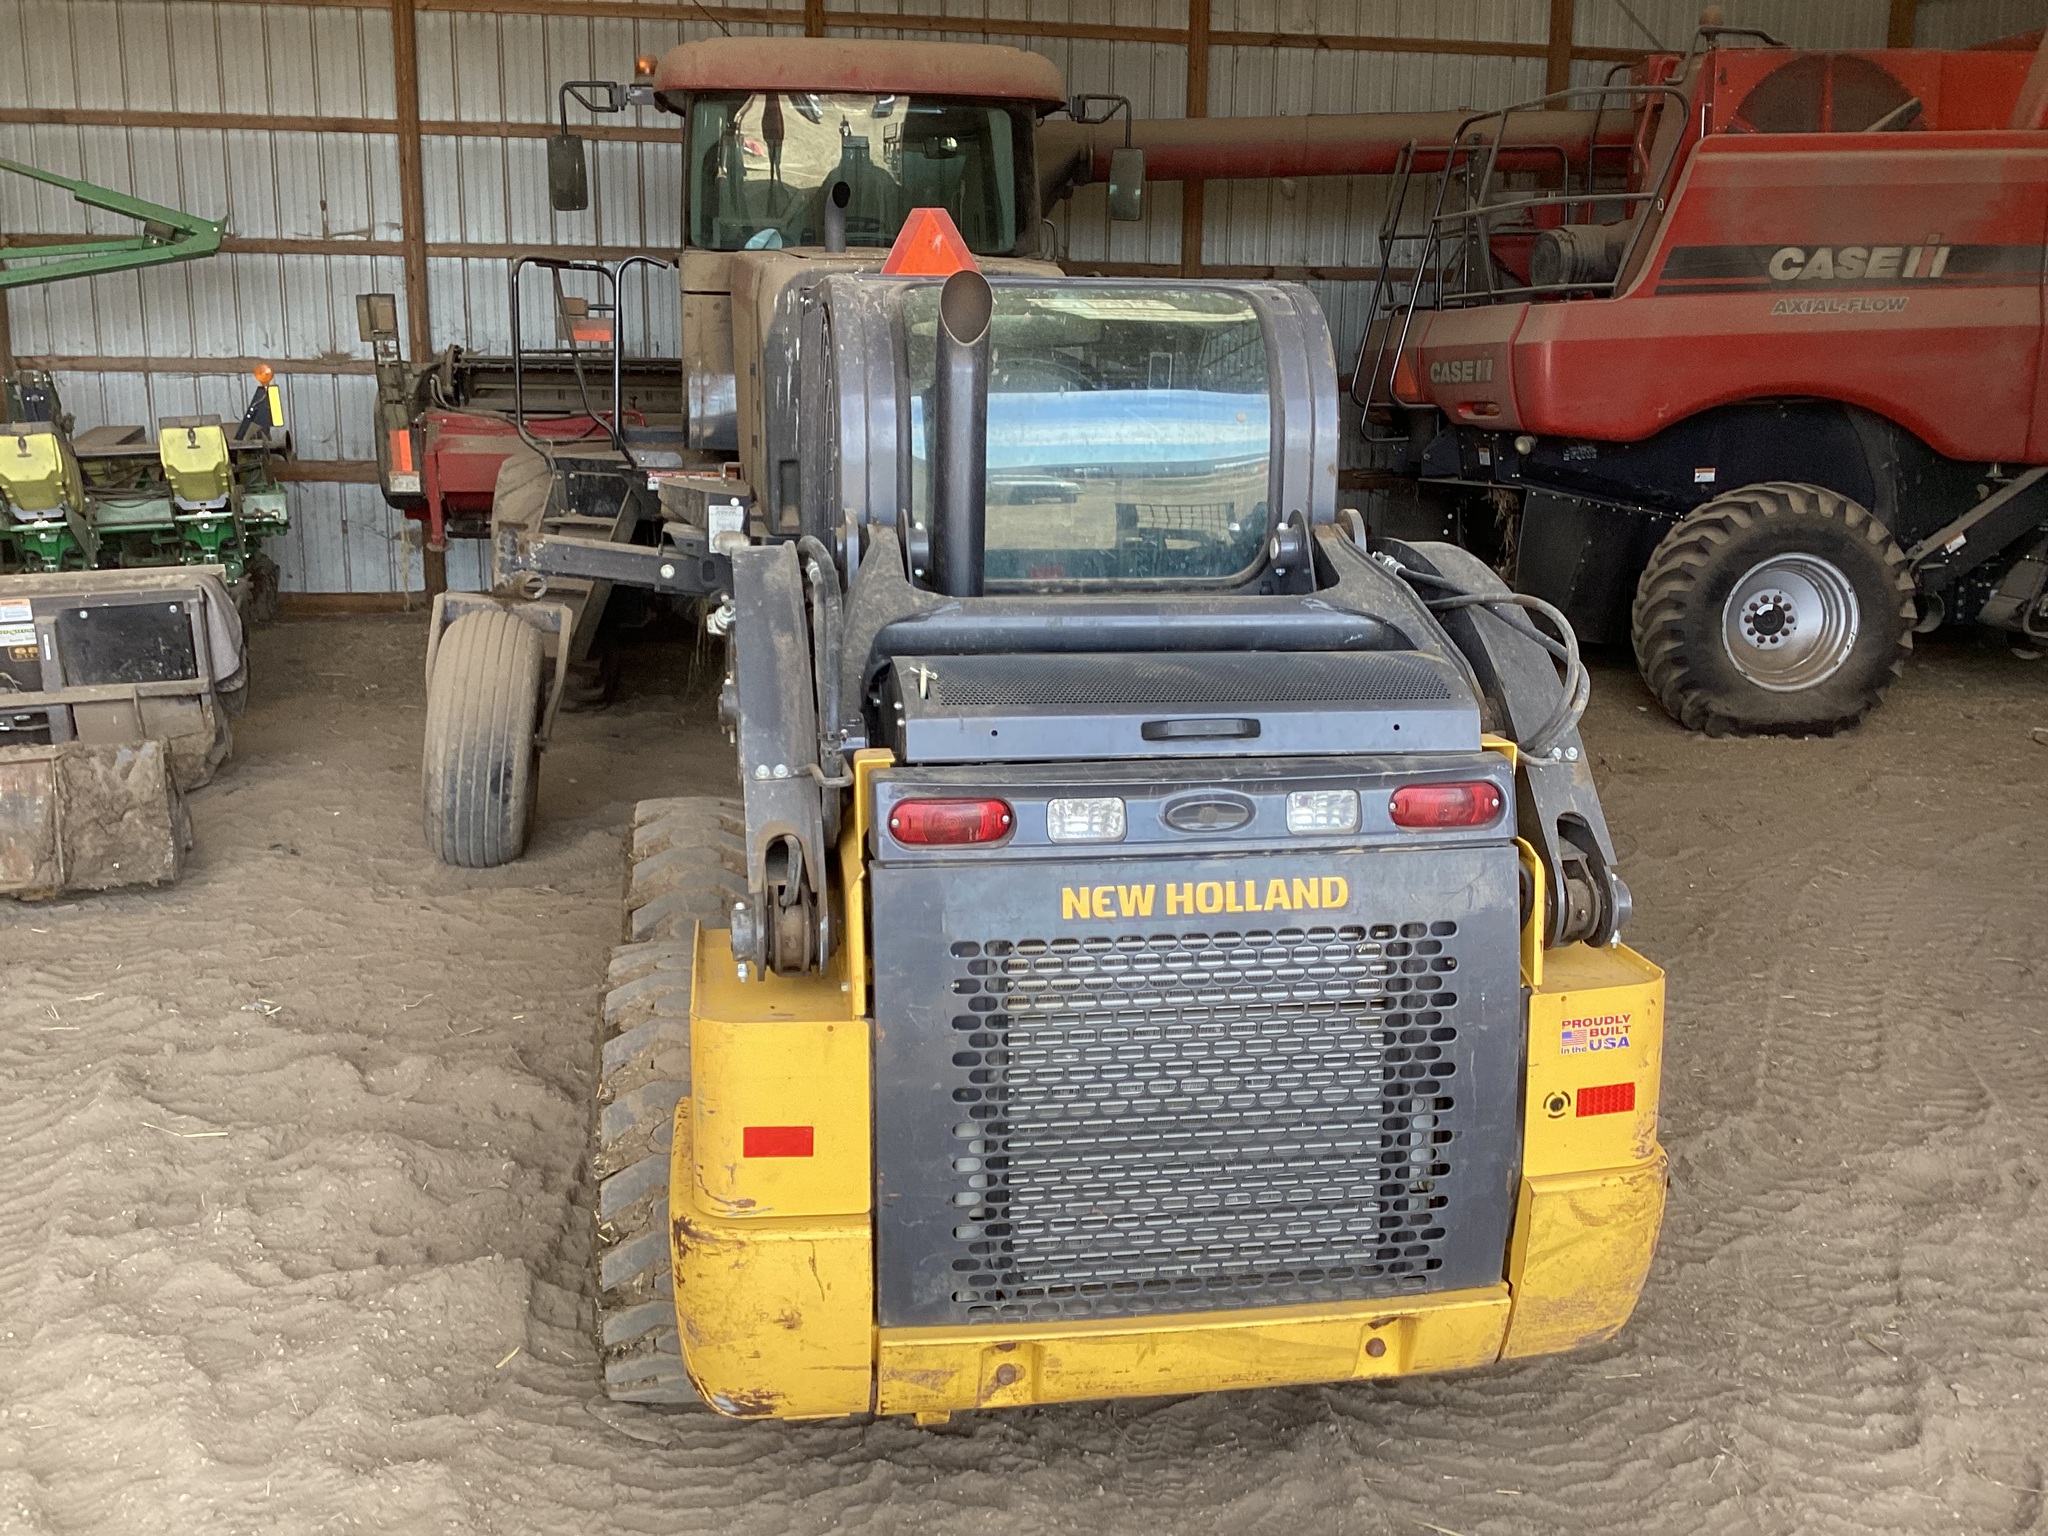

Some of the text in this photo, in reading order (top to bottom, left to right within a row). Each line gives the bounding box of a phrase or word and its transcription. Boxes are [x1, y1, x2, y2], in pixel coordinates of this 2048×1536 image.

[1768, 246, 1903, 280] CASE
[1771, 296, 1909, 316] AXIAL-FLOW
[1430, 360, 1474, 383] CASE
[1062, 876, 1349, 919] NEW HOLLAND
[1561, 1014, 1631, 1029] PROUDLY
[1589, 1025, 1631, 1037] BUILT
[1589, 1036, 1630, 1051] USA
